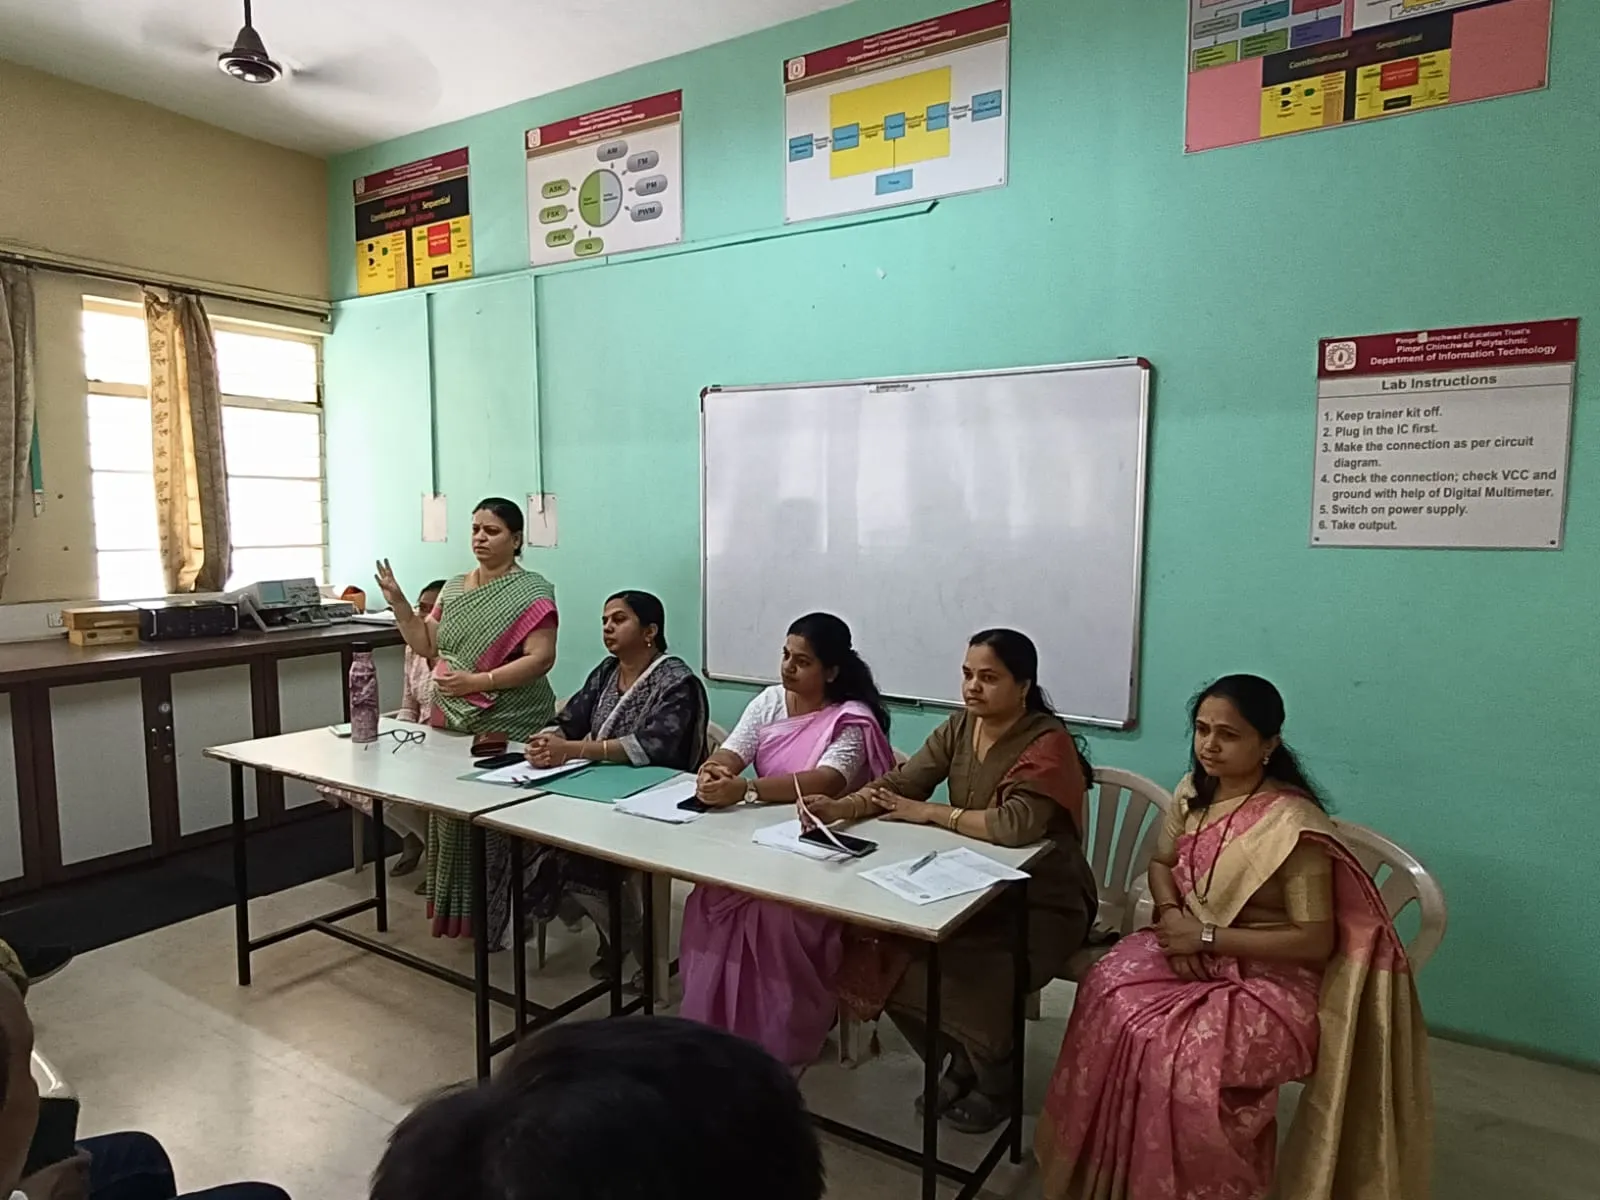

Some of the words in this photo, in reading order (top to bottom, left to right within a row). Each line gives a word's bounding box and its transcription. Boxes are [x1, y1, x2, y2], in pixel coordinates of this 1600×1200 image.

[638, 158, 648, 166] FM
[638, 207, 655, 216] PWM
[1464, 331, 1502, 339] Education
[1397, 345, 1423, 353] Pimpri
[1426, 341, 1473, 351] Chinchwad
[1476, 337, 1528, 348] Polytechnic
[1371, 353, 1423, 365] Department
[1426, 352, 1436, 361] of
[1439, 350, 1494, 361] Information
[1498, 345, 1556, 356] Technology
[1382, 379, 1407, 390] Lab
[1411, 375, 1497, 389] Instructions
[1324, 412, 1332, 421] 1.
[1336, 411, 1364, 422] Keep
[1367, 410, 1403, 420] trainer
[1407, 408, 1420, 417] kit
[1424, 406, 1442, 417] off.
[1323, 428, 1332, 437] 2.
[1336, 427, 1359, 438] Plug
[1363, 426, 1373, 435] in
[1377, 426, 1393, 435] the
[1397, 424, 1408, 434] IC
[1412, 424, 1439, 433] first.
[1322, 443, 1331, 452] 3.
[1335, 442, 1363, 452] Make
[1366, 442, 1383, 451] the
[1386, 440, 1450, 450] connection
[1454, 440, 1467, 448] as
[1471, 439, 1491, 450] per
[1494, 436, 1534, 447] circuit
[1334, 458, 1381, 469] diagram.
[1321, 475, 1329, 483] 4.
[1333, 473, 1366, 483] Check
[1371, 473, 1387, 482] the
[1391, 471, 1459, 482] connection;
[1462, 471, 1498, 481] check
[1502, 470, 1529, 480] VCC
[1533, 469, 1556, 480] and
[1332, 489, 1371, 501] ground
[1375, 489, 1397, 498] with
[1401, 489, 1425, 500] help
[1428, 488, 1440, 498] of
[1444, 487, 1481, 500] Digital
[1485, 487, 1553, 497] Multimeter.
[1320, 505, 1328, 514] 5.
[1332, 504, 1368, 514] Switch
[1371, 506, 1385, 514] on
[1388, 505, 1423, 516] power
[1427, 504, 1468, 516] supply.
[1319, 521, 1327, 530] 6.
[1331, 520, 1355, 529] Take
[1359, 520, 1397, 531] output.
